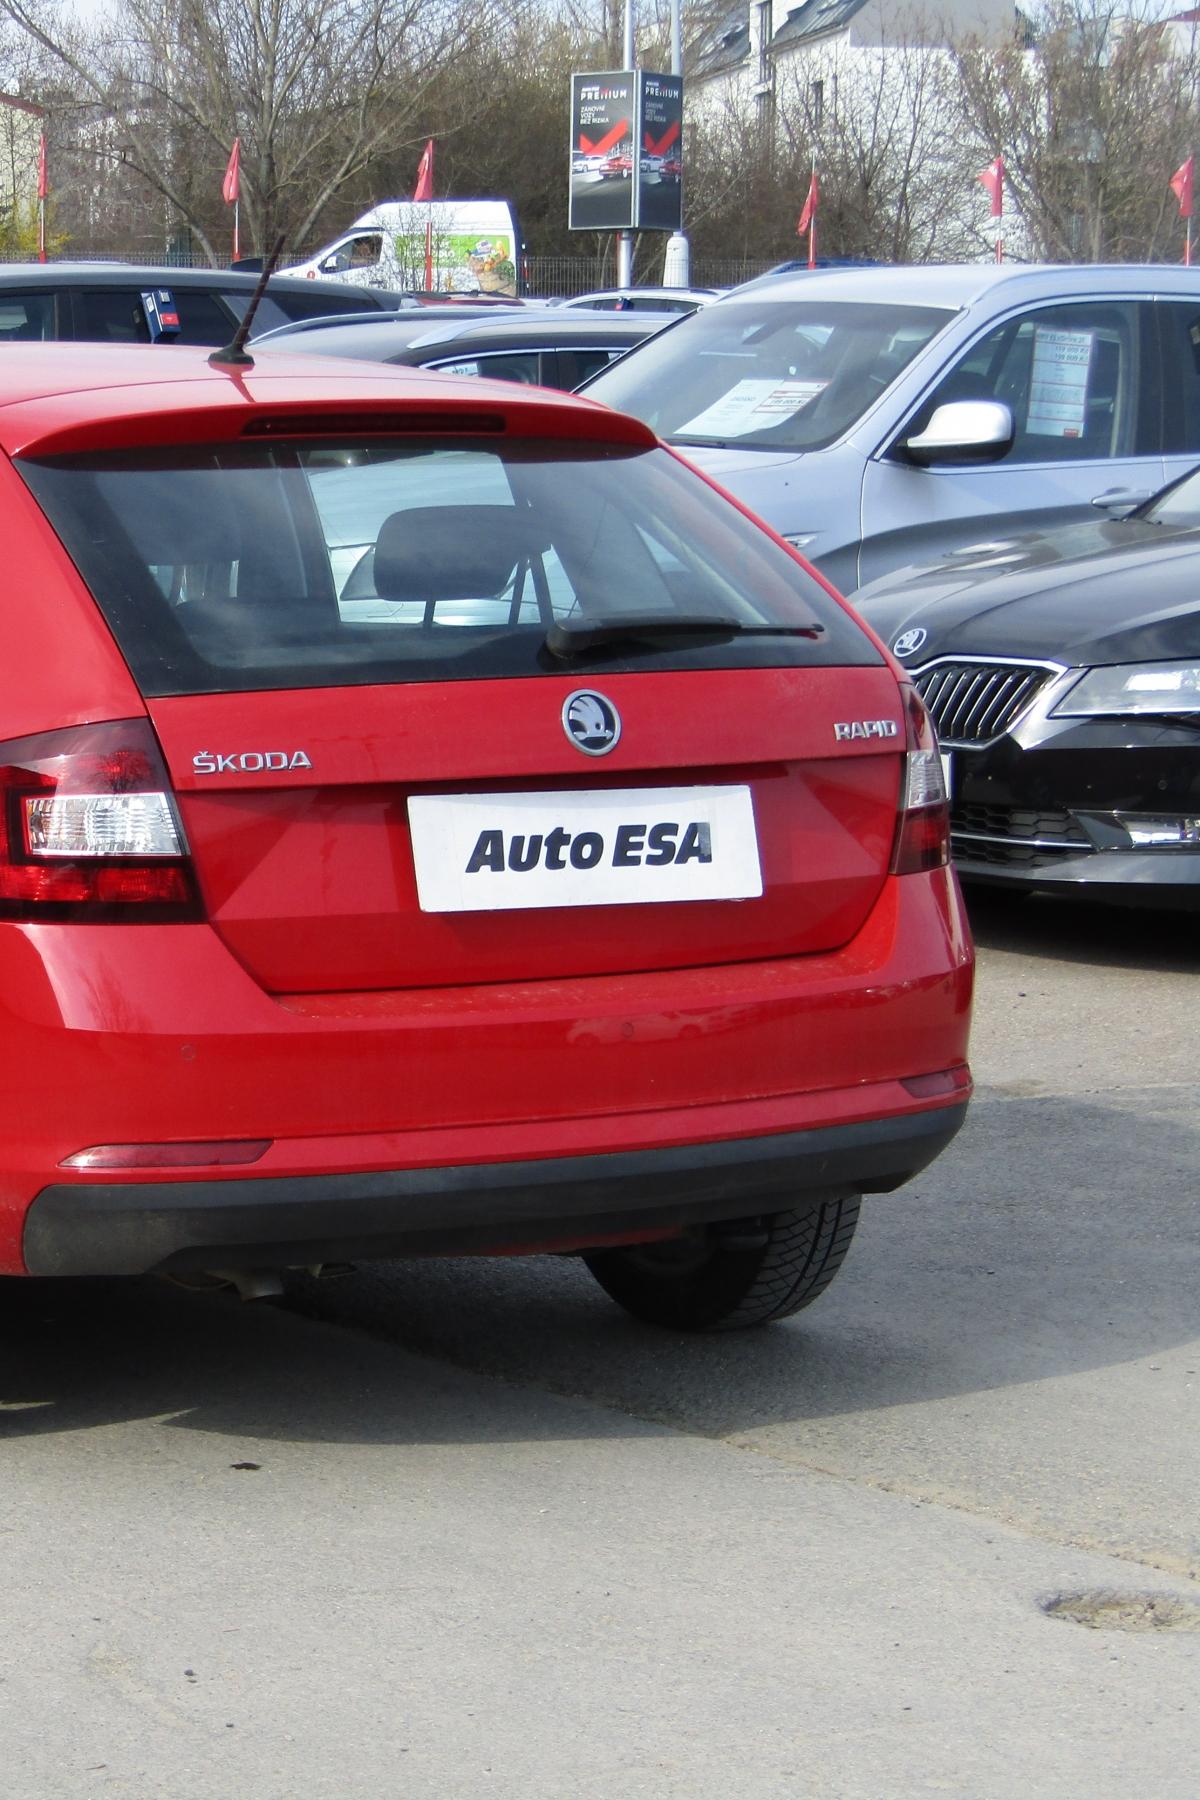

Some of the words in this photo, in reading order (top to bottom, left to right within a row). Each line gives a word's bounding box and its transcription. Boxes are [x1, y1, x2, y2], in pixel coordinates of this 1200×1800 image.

[580, 88, 628, 101] PREMIUM
[645, 86, 679, 99] PREMIUM
[833, 720, 897, 741] RAPID
[192, 751, 312, 774] ŠKODA
[465, 827, 604, 873] Auto
[612, 822, 712, 867] ESA
